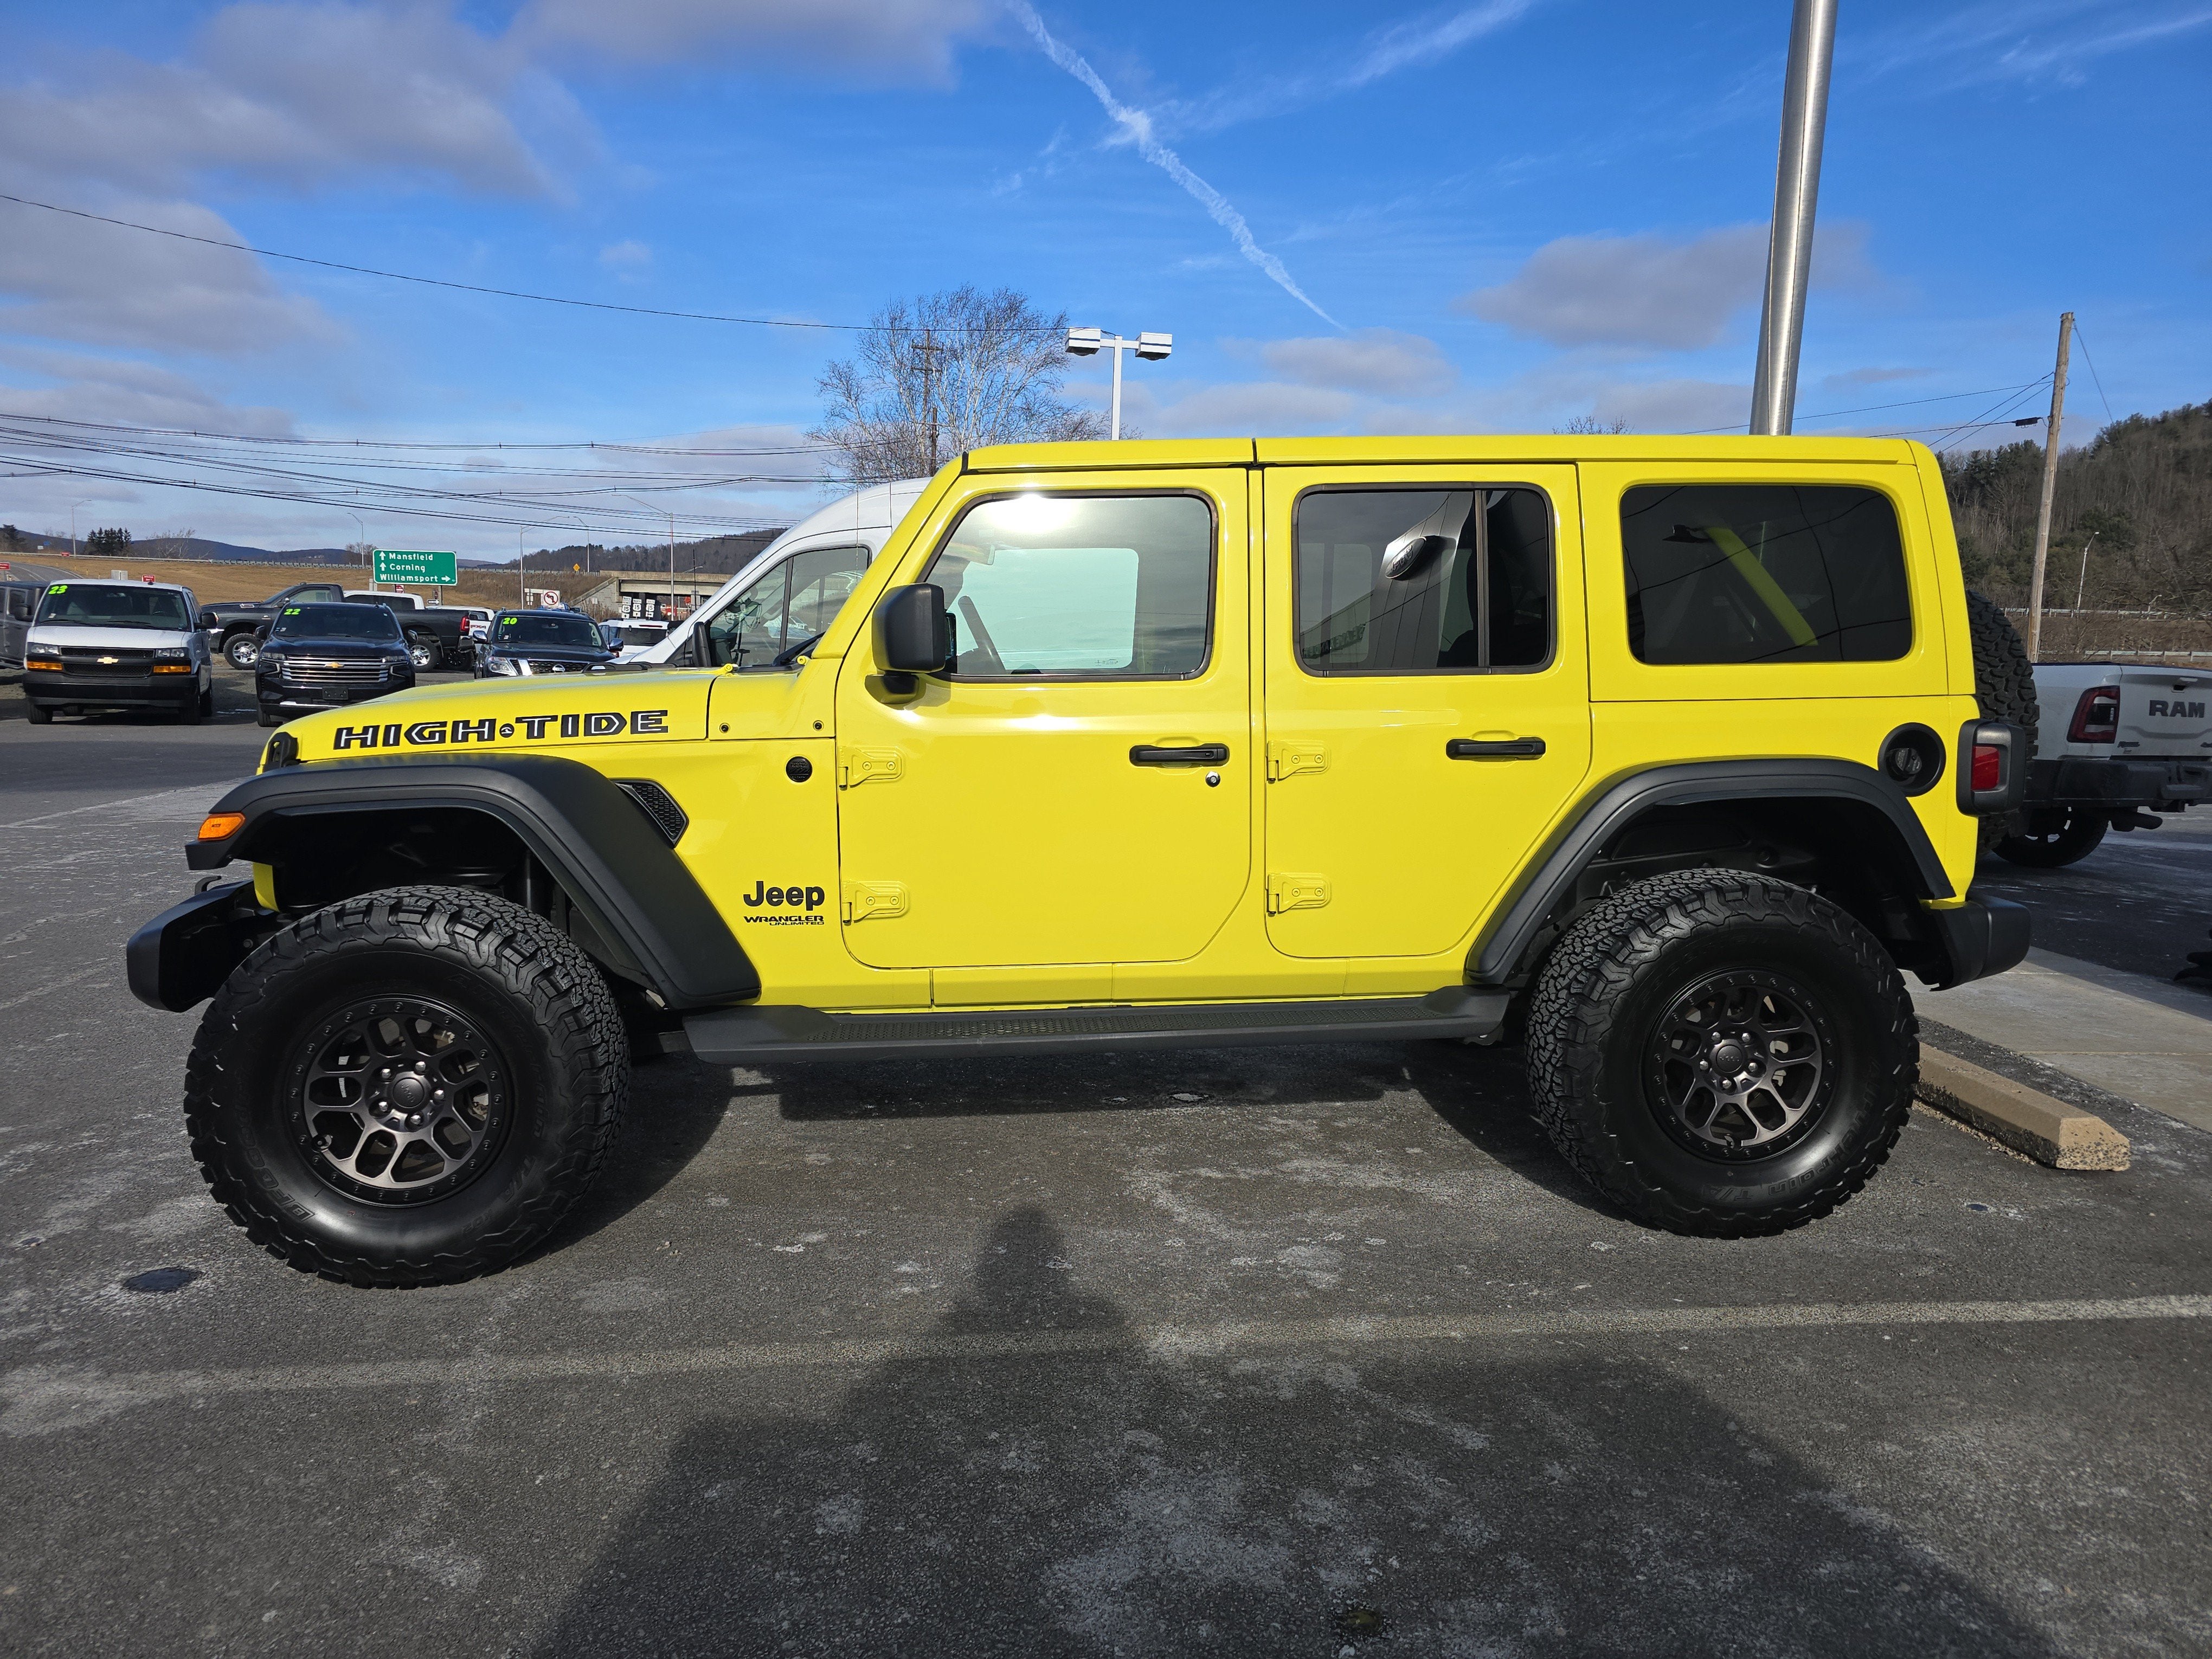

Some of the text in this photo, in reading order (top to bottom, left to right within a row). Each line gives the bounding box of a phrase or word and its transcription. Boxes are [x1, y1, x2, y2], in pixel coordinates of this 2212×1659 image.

[389, 552, 433, 561] Mansfield
[389, 563, 426, 573] Corning
[380, 574, 438, 582] Williamsport
[48, 585, 68, 595] 23
[2149, 699, 2205, 718] RAM
[332, 710, 669, 750] HIGH TIDE
[743, 880, 825, 911] Jeep
[743, 915, 824, 923] WRANGLER
